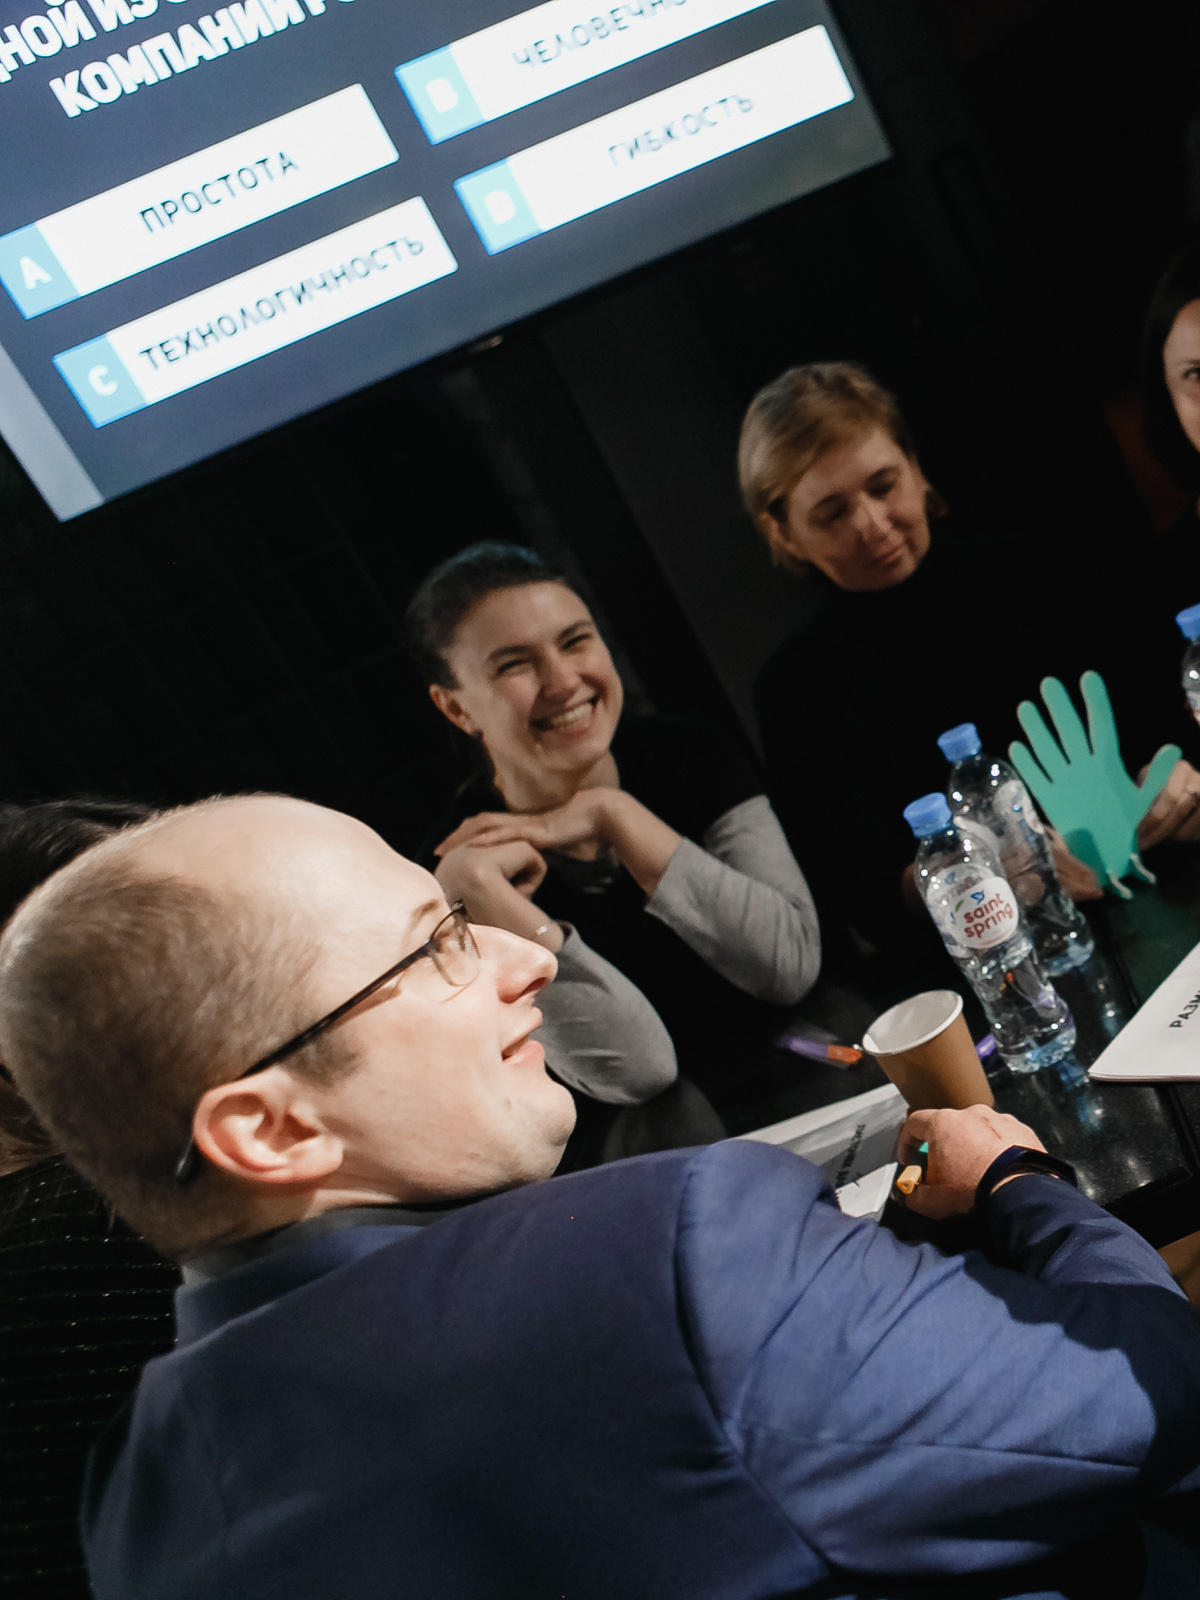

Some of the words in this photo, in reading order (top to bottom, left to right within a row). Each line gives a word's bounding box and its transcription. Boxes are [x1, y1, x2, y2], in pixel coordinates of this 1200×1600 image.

[0, 0, 98, 84] НОЙ
[49, 0, 306, 118] КОМПАНИИ
[425, 77, 460, 113] B
[607, 94, 755, 166] ГИБКОСТЬ
[138, 151, 300, 234] ПРОСТОТА
[483, 189, 517, 226] D
[18, 255, 52, 291] A
[138, 235, 426, 370] ТЕХНОЛОГИЧНОСТЬ
[86, 363, 119, 397] C
[963, 893, 1004, 923] saint
[964, 903, 1013, 939] spring
